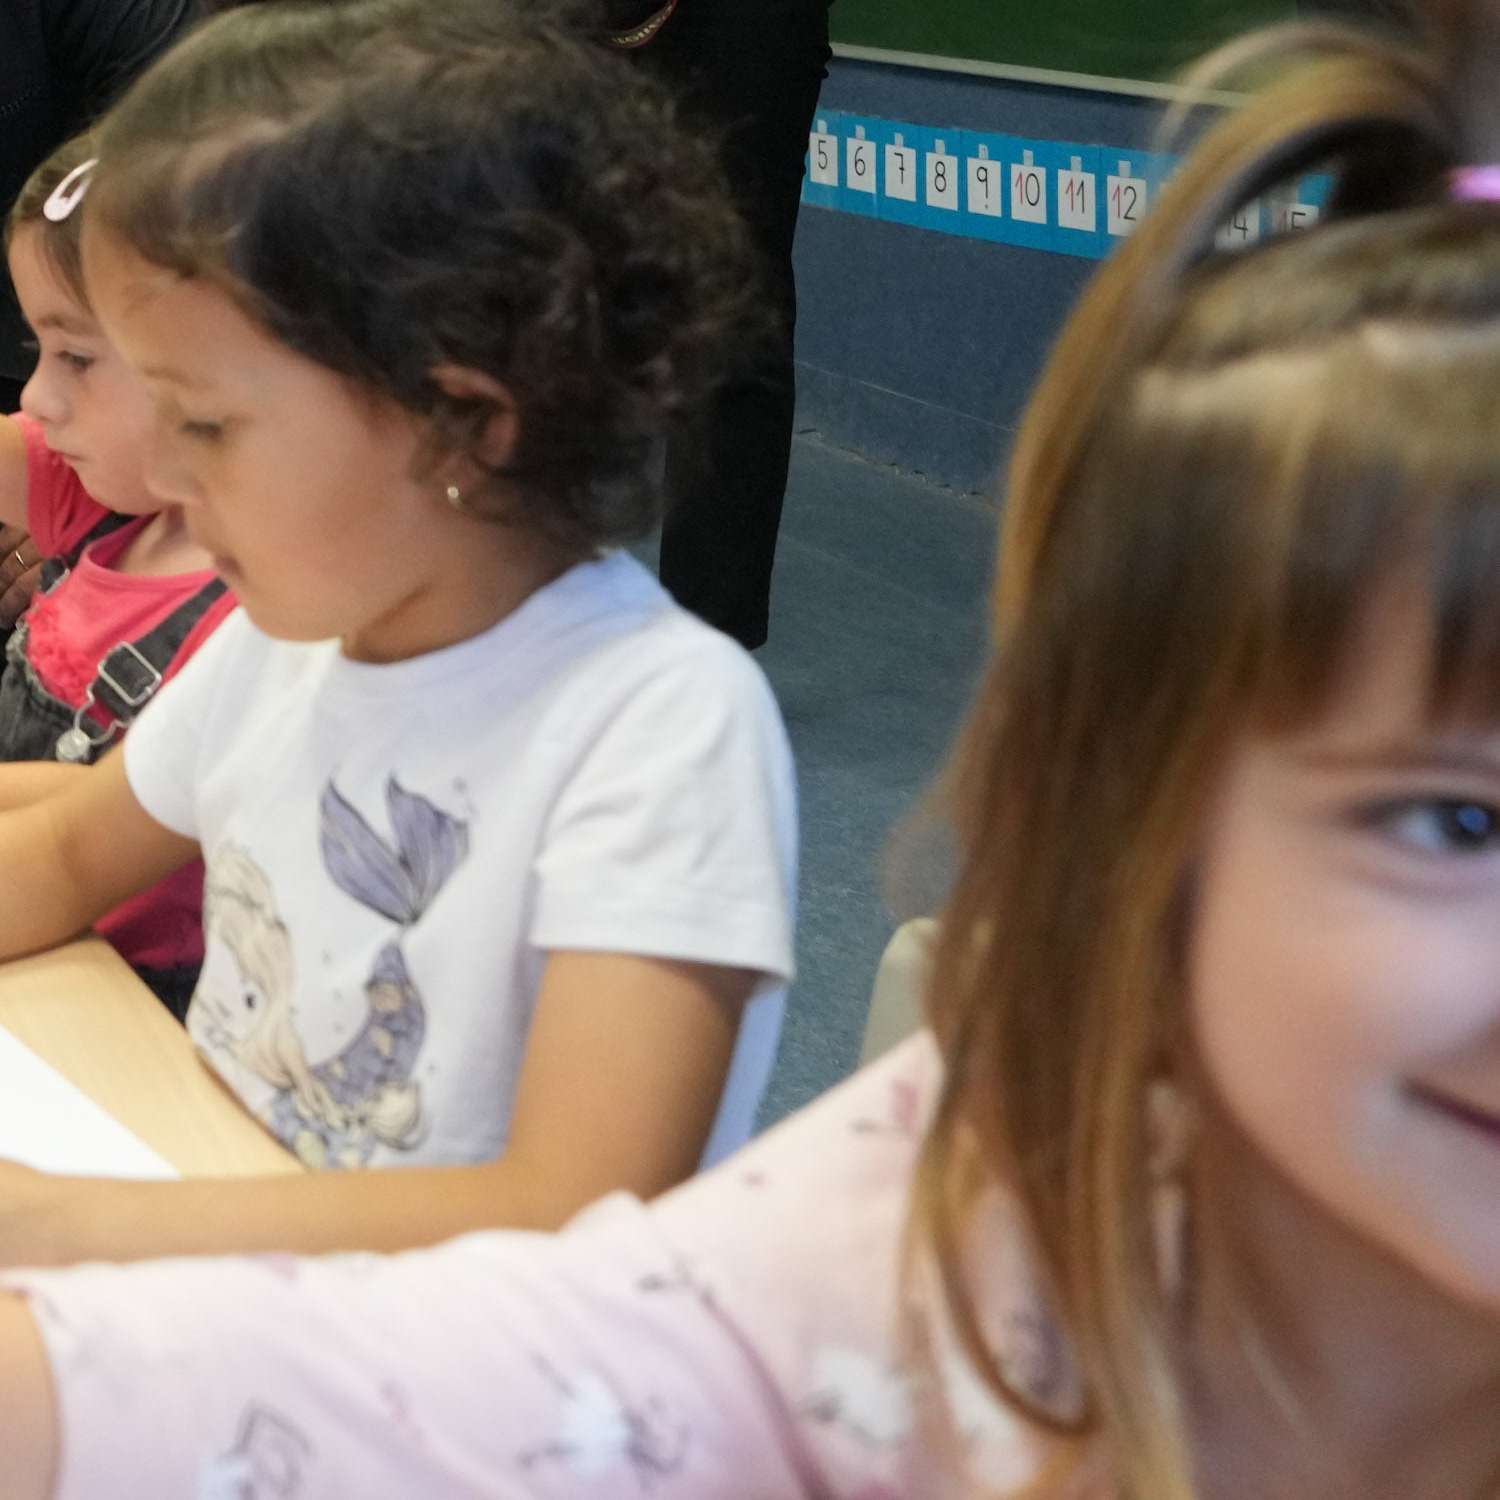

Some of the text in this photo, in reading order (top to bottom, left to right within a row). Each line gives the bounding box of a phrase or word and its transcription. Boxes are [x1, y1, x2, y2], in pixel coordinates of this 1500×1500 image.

[817, 139, 829, 170] 5
[854, 146, 866, 177] 6
[893, 151, 904, 184] 7
[934, 160, 947, 193] 8
[976, 166, 988, 199] 9
[1014, 171, 1041, 207] 10
[1064, 177, 1086, 214] 11
[1112, 183, 1138, 221] 12
